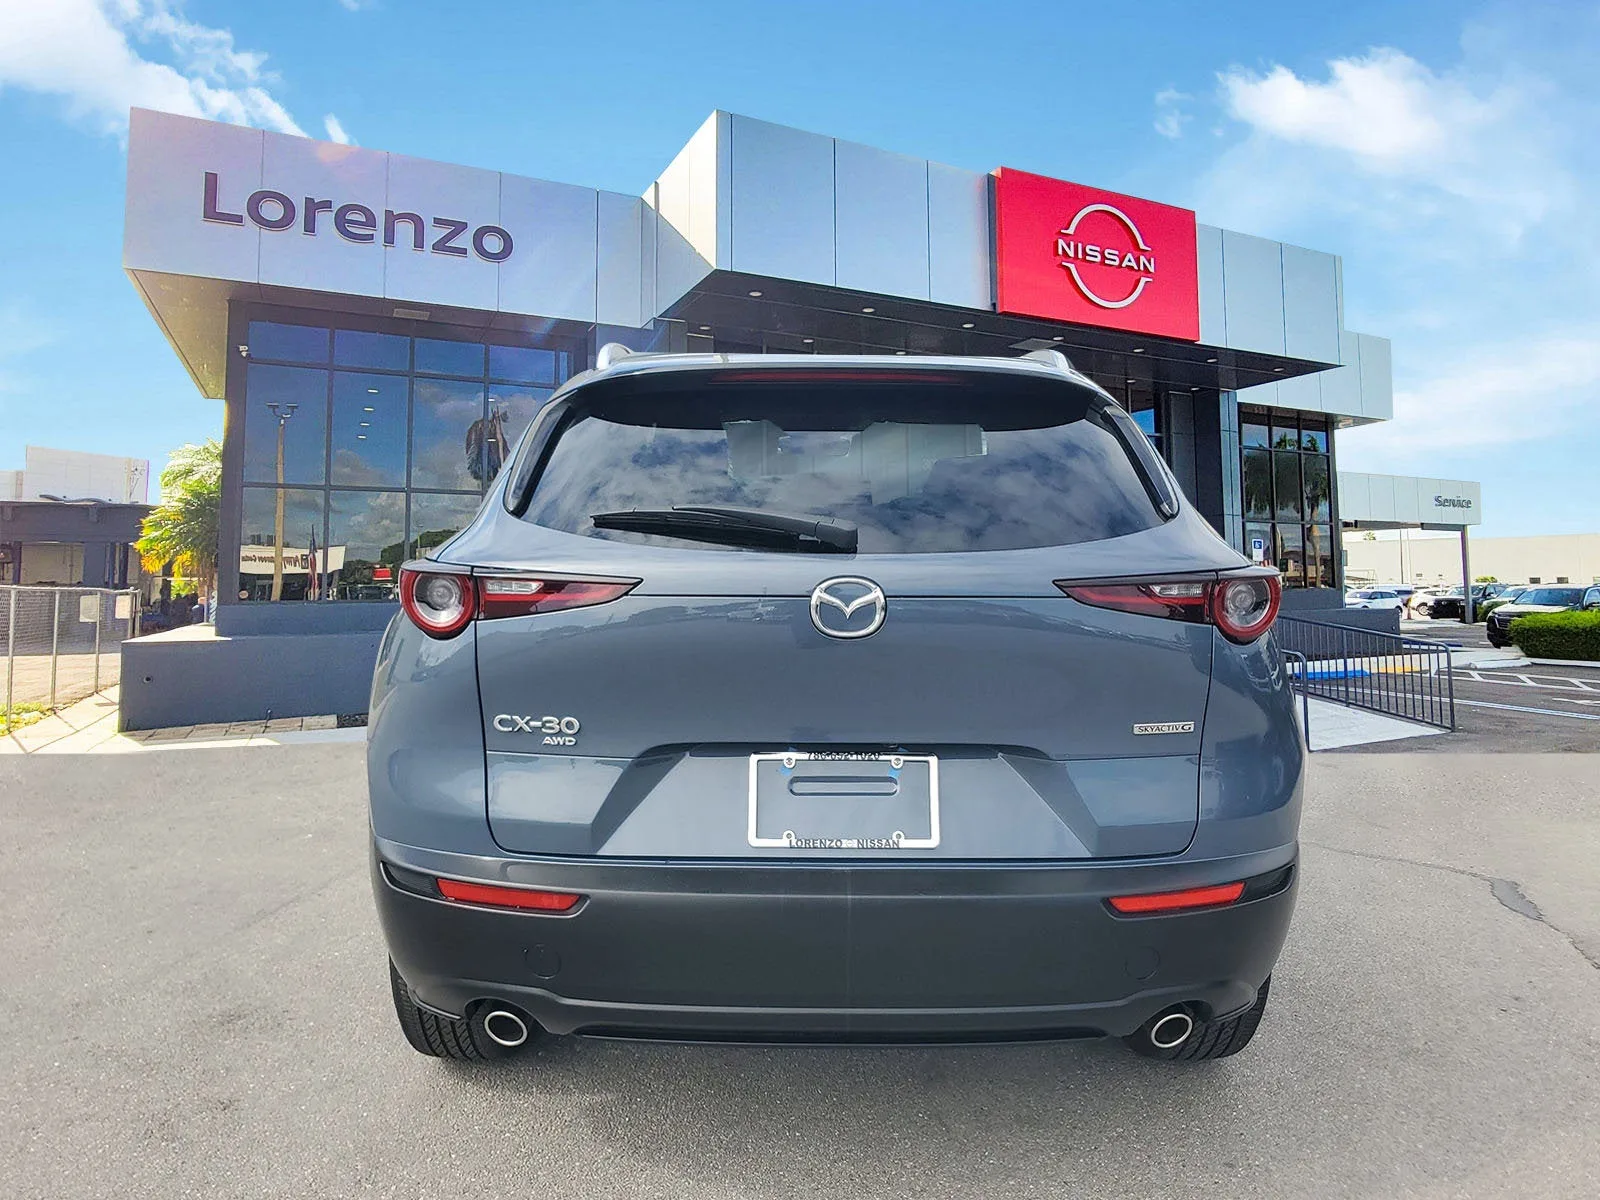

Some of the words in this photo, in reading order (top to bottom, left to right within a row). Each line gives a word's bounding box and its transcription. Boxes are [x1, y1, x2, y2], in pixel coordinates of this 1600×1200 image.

[202, 171, 515, 262] Lorenzo
[1057, 238, 1155, 273] NISSAN
[1434, 495, 1472, 509] Service
[493, 714, 581, 735] CX-30
[541, 736, 577, 746] AWD
[789, 839, 842, 849] LORENZO
[857, 839, 900, 849] NISSAN
